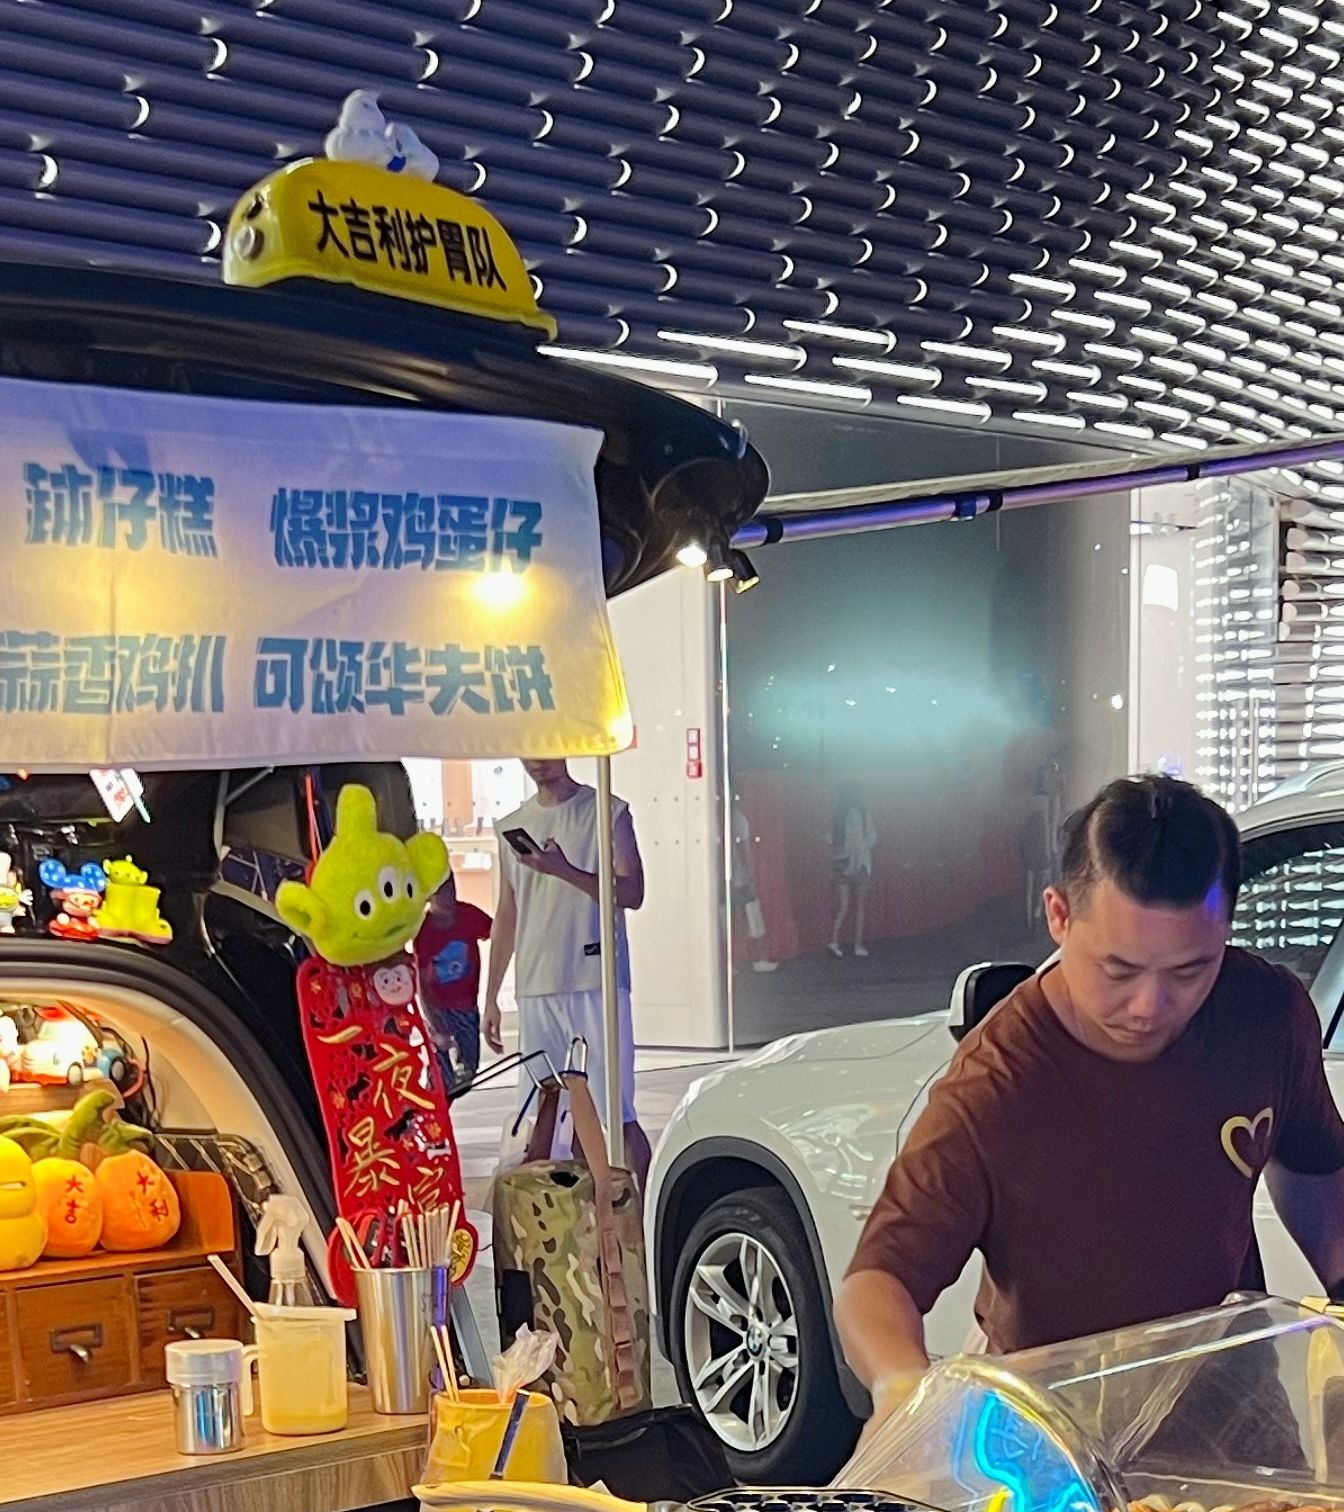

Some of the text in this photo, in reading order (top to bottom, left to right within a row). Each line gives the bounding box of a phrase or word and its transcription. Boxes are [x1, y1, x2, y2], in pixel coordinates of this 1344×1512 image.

[308, 189, 507, 291] 大吉利护胃队
[22, 461, 544, 576] 钵仔糕 爆浆鸡蛋仔
[256, 635, 557, 718] 可颂华夫饼
